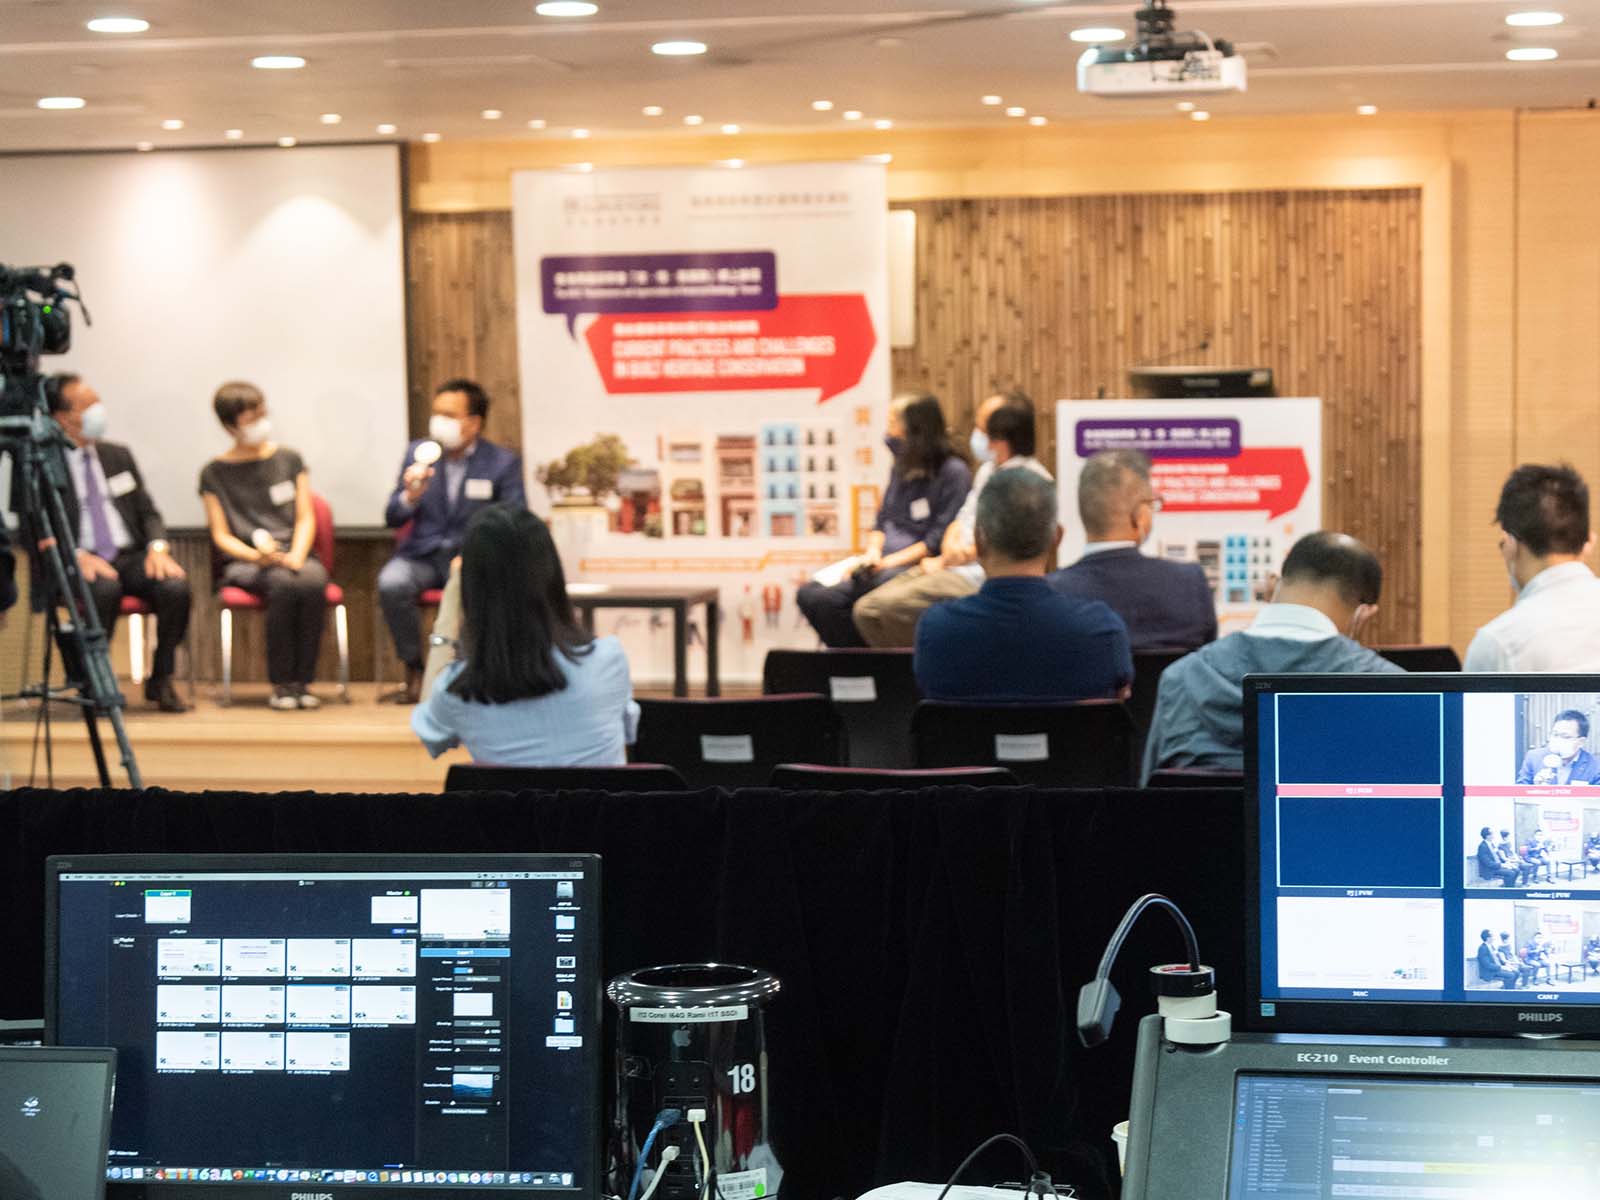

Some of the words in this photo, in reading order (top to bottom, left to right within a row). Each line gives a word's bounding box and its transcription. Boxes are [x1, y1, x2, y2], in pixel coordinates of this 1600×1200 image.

[612, 340, 665, 358] CURRENT
[668, 338, 730, 357] PRACTICES
[734, 337, 756, 355] AND
[759, 335, 836, 355] CHALLENGES
[663, 359, 715, 377] HERITAGE
[718, 357, 805, 376] CONSERVATION
[1518, 1012, 1563, 1022] PHILIPS
[1296, 1053, 1338, 1063] EC-210
[1349, 1054, 1385, 1064] Event
[1388, 1055, 1450, 1066] Controller
[727, 1063, 756, 1095] 18
[291, 1192, 333, 1200] PHILIPS
